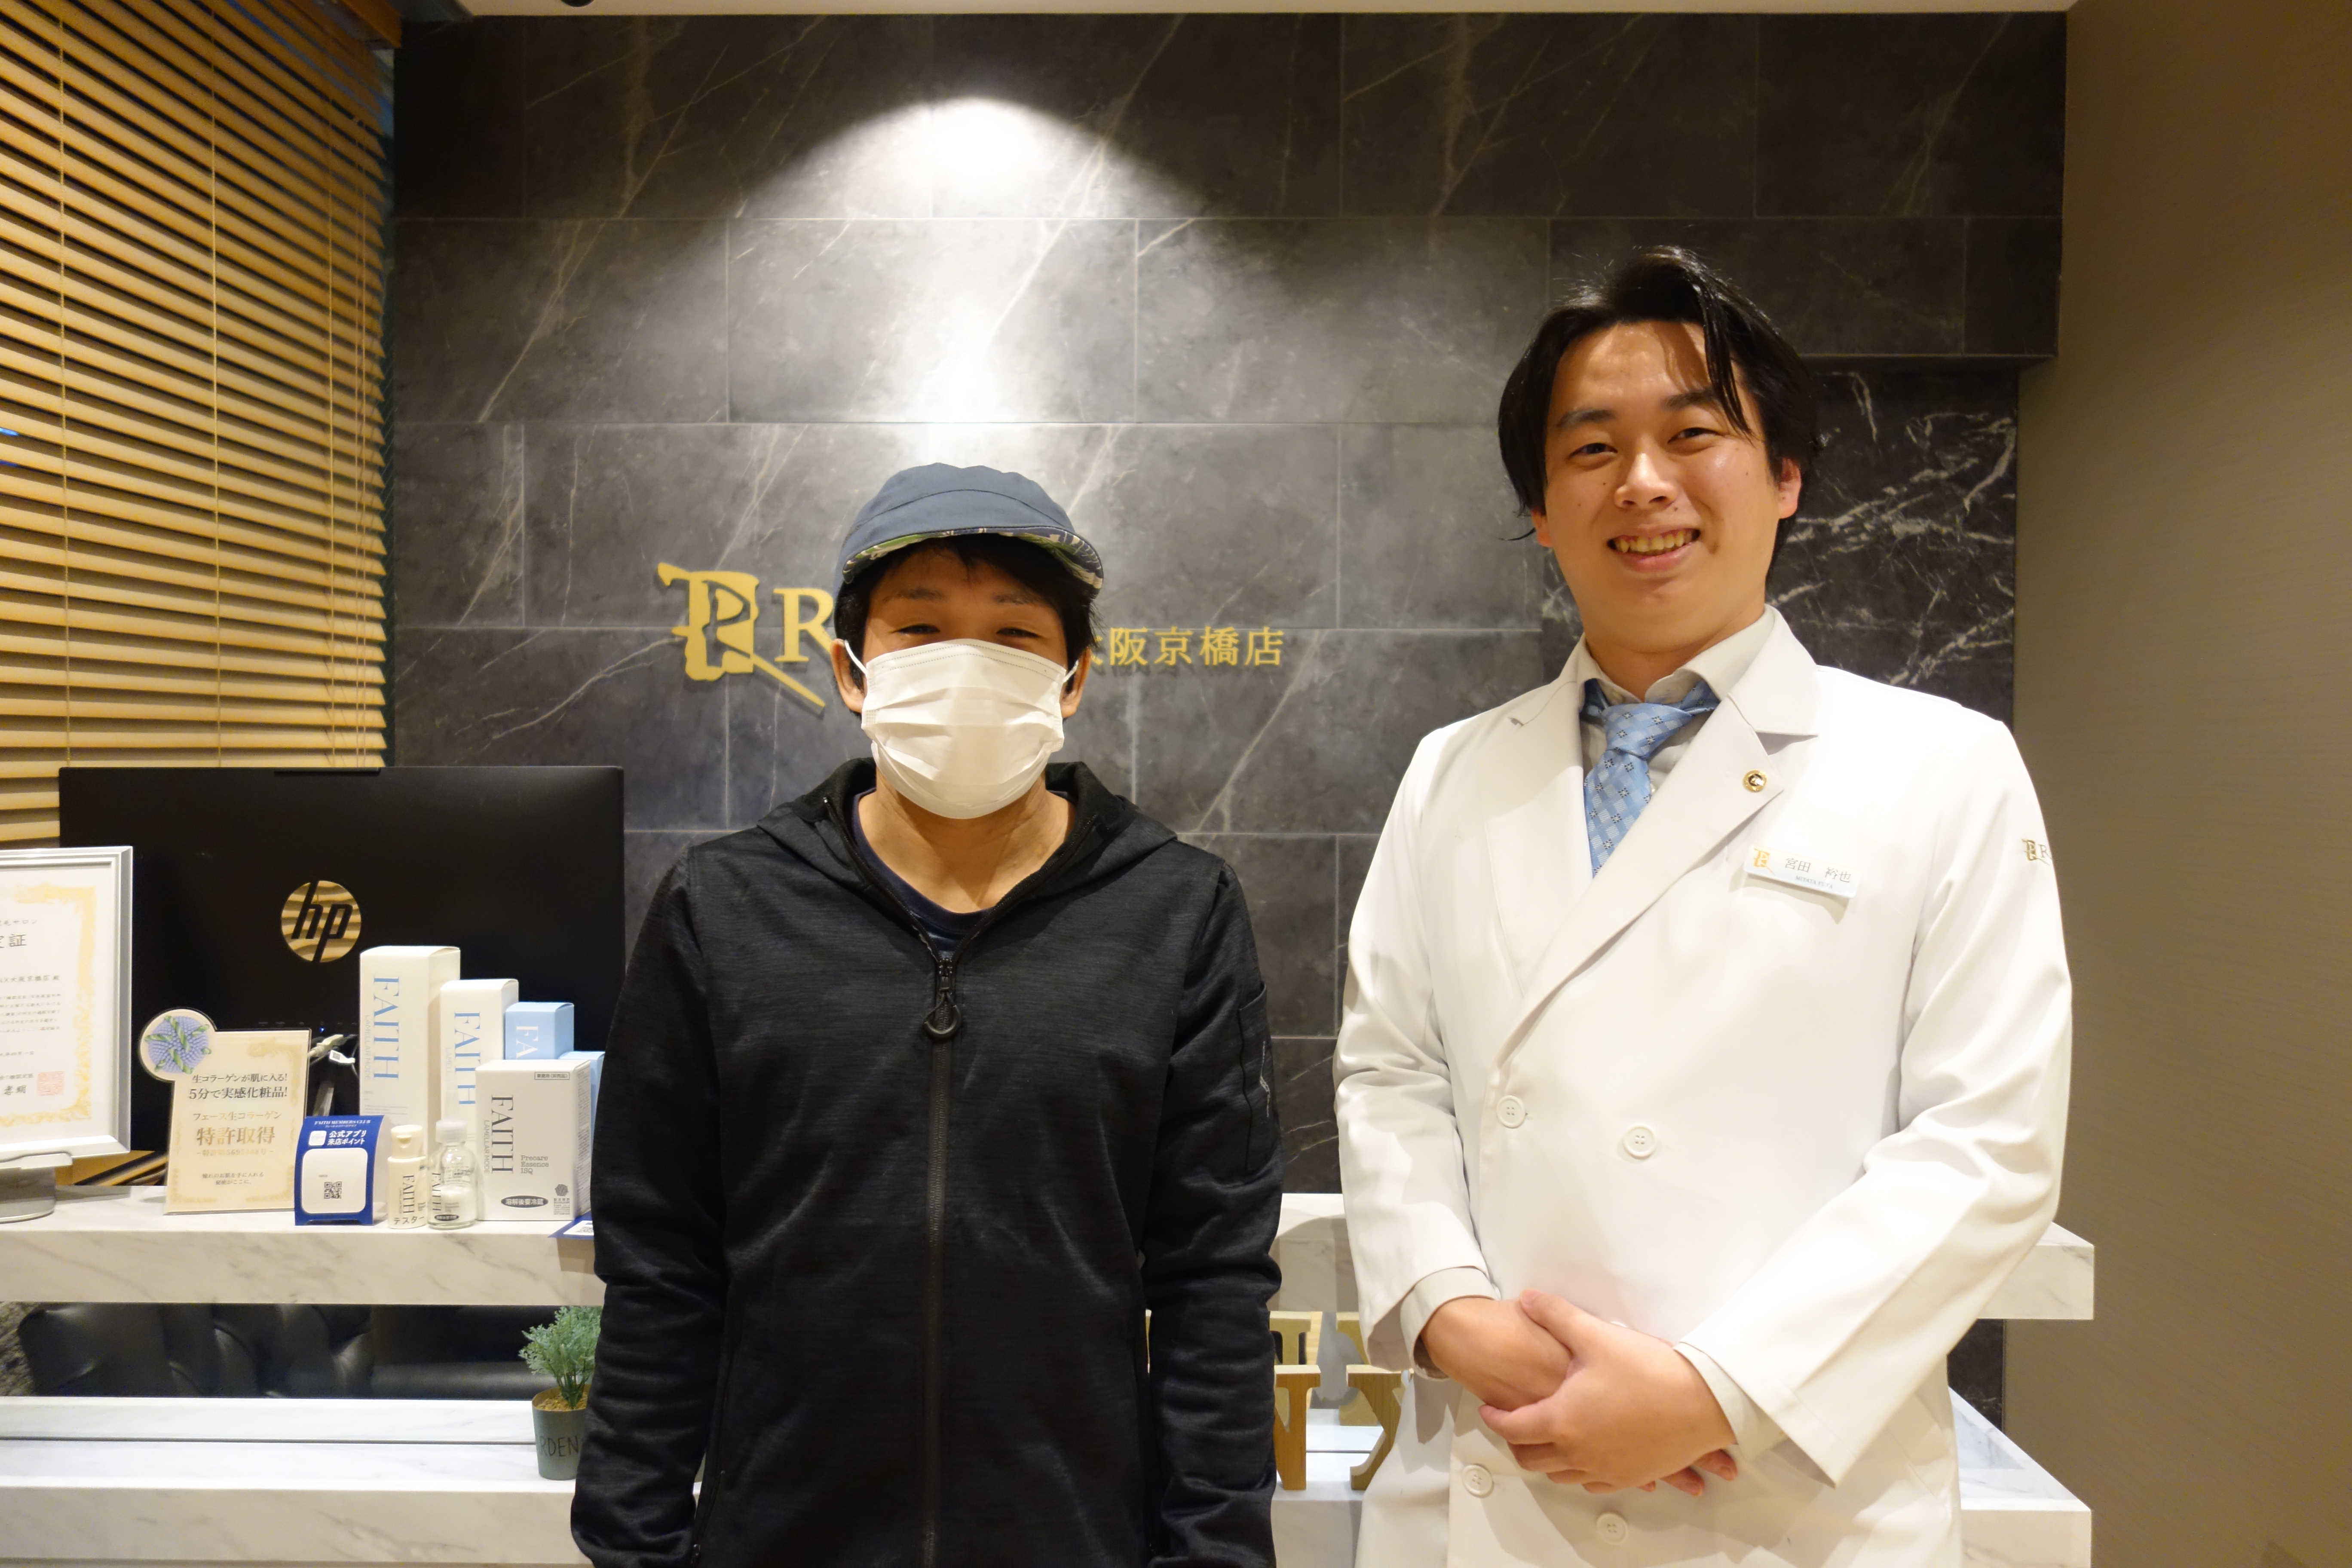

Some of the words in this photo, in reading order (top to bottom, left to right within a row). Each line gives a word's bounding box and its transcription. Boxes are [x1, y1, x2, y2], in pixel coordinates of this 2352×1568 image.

[1785, 858, 1811, 873] 宮田
[291, 881, 353, 962] hp
[373, 976, 400, 1080] FAITH
[454, 1012, 481, 1105] FAITH
[192, 1073, 288, 1084] 生コラーゲンが肌に入る!
[189, 1087, 288, 1099] 5分で実感化粧品!
[193, 1111, 282, 1121] フェース生コラーゲン
[196, 1126, 275, 1146] 特許取得
[329, 1130, 367, 1138] 公式アプリ
[491, 1094, 514, 1173] FAITH
[394, 1216, 425, 1225] テスター
[539, 1435, 579, 1457] RDEN
